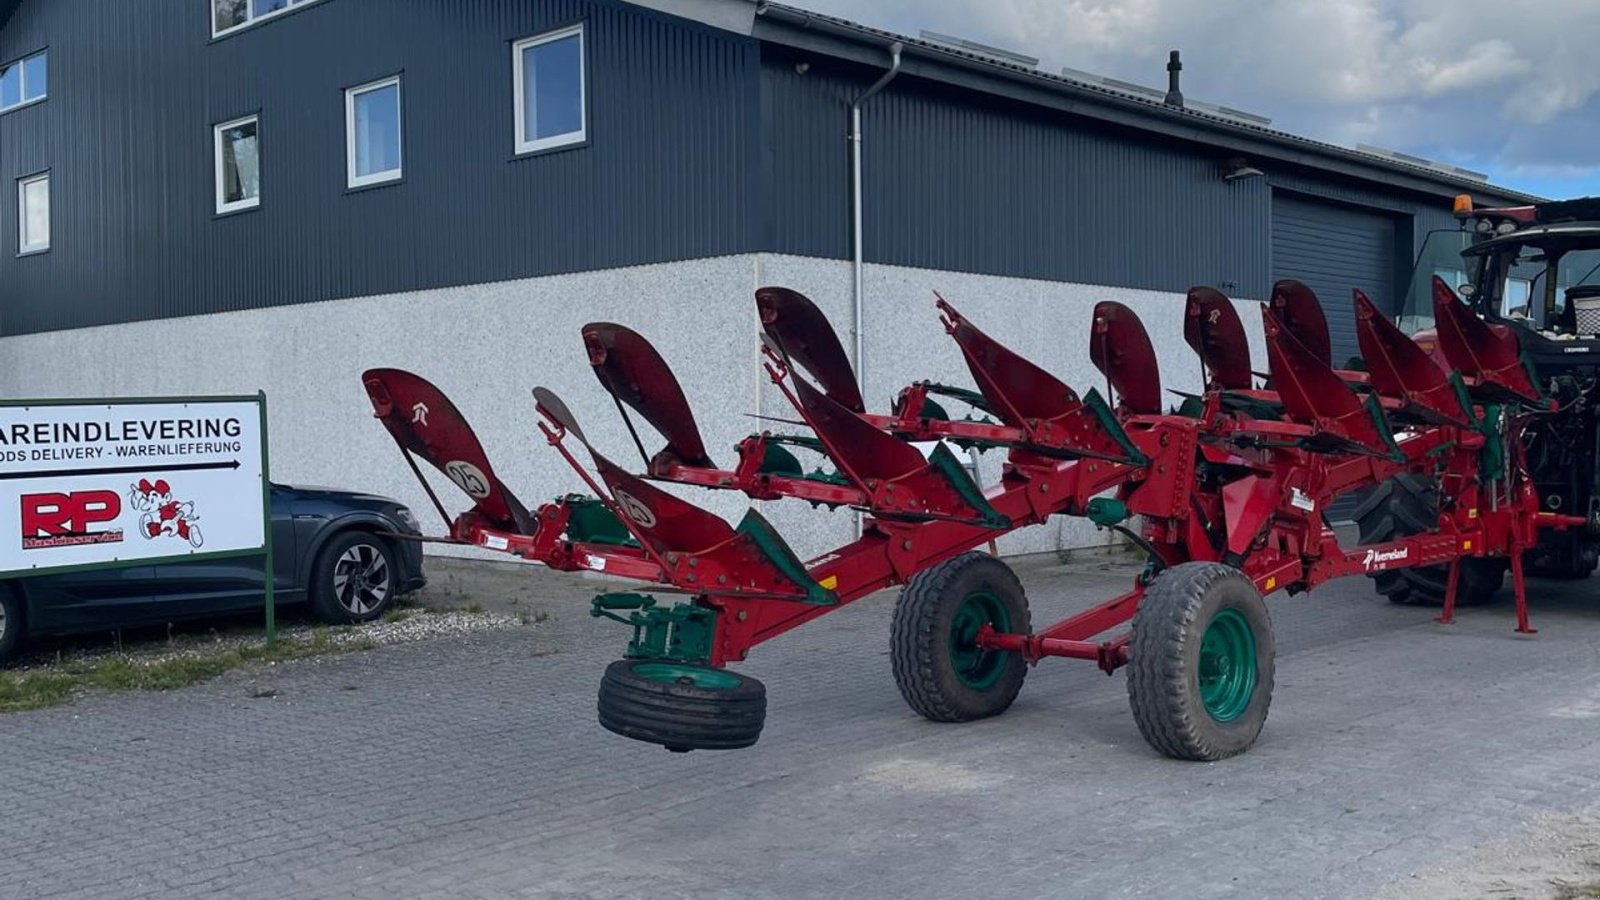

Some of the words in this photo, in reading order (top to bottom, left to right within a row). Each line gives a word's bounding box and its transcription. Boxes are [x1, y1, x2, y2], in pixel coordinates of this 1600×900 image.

[31, 447, 103, 461] DELIVERY
[115, 441, 241, 457] WARENLIEFERUNG
[450, 464, 487, 494] 25
[20, 489, 121, 536] RP
